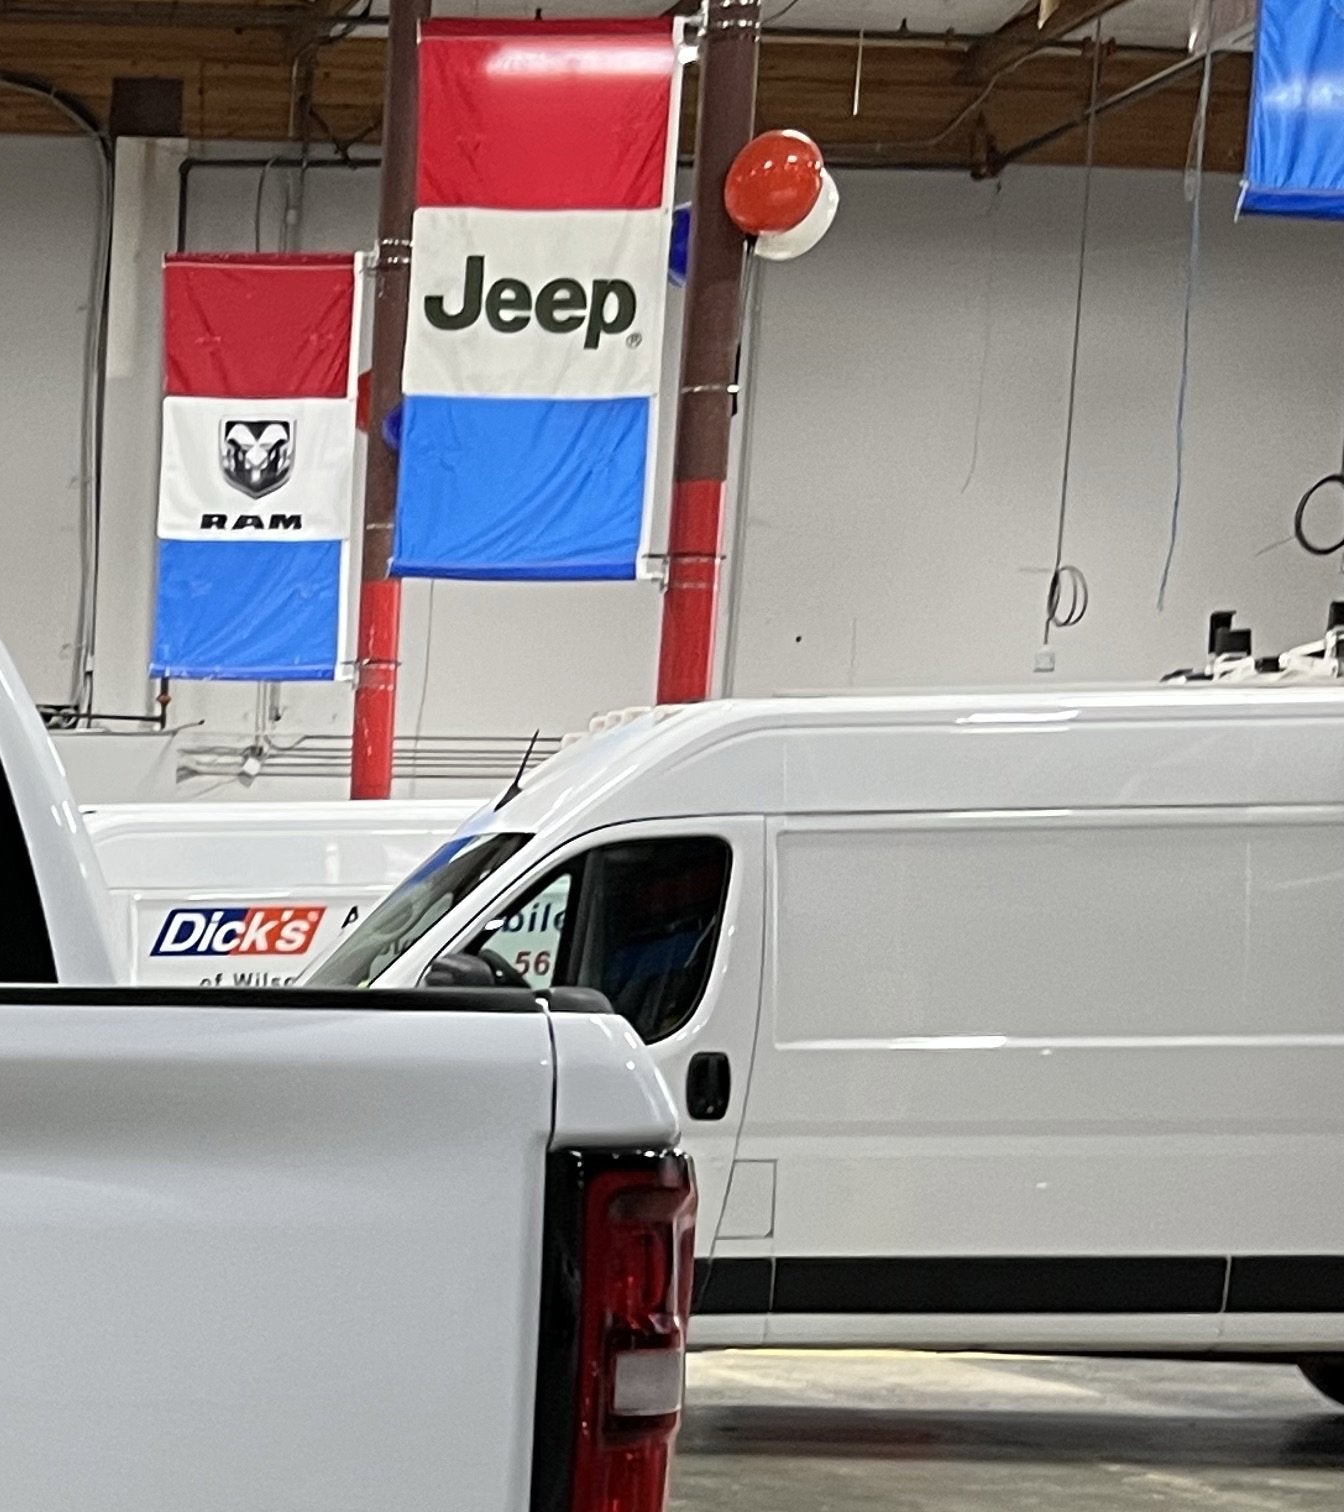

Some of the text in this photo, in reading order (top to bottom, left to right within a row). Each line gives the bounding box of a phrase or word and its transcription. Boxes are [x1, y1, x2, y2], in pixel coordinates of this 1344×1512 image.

[424, 255, 637, 349] Jeep
[200, 513, 303, 531] RAM
[159, 909, 312, 953] Dick's
